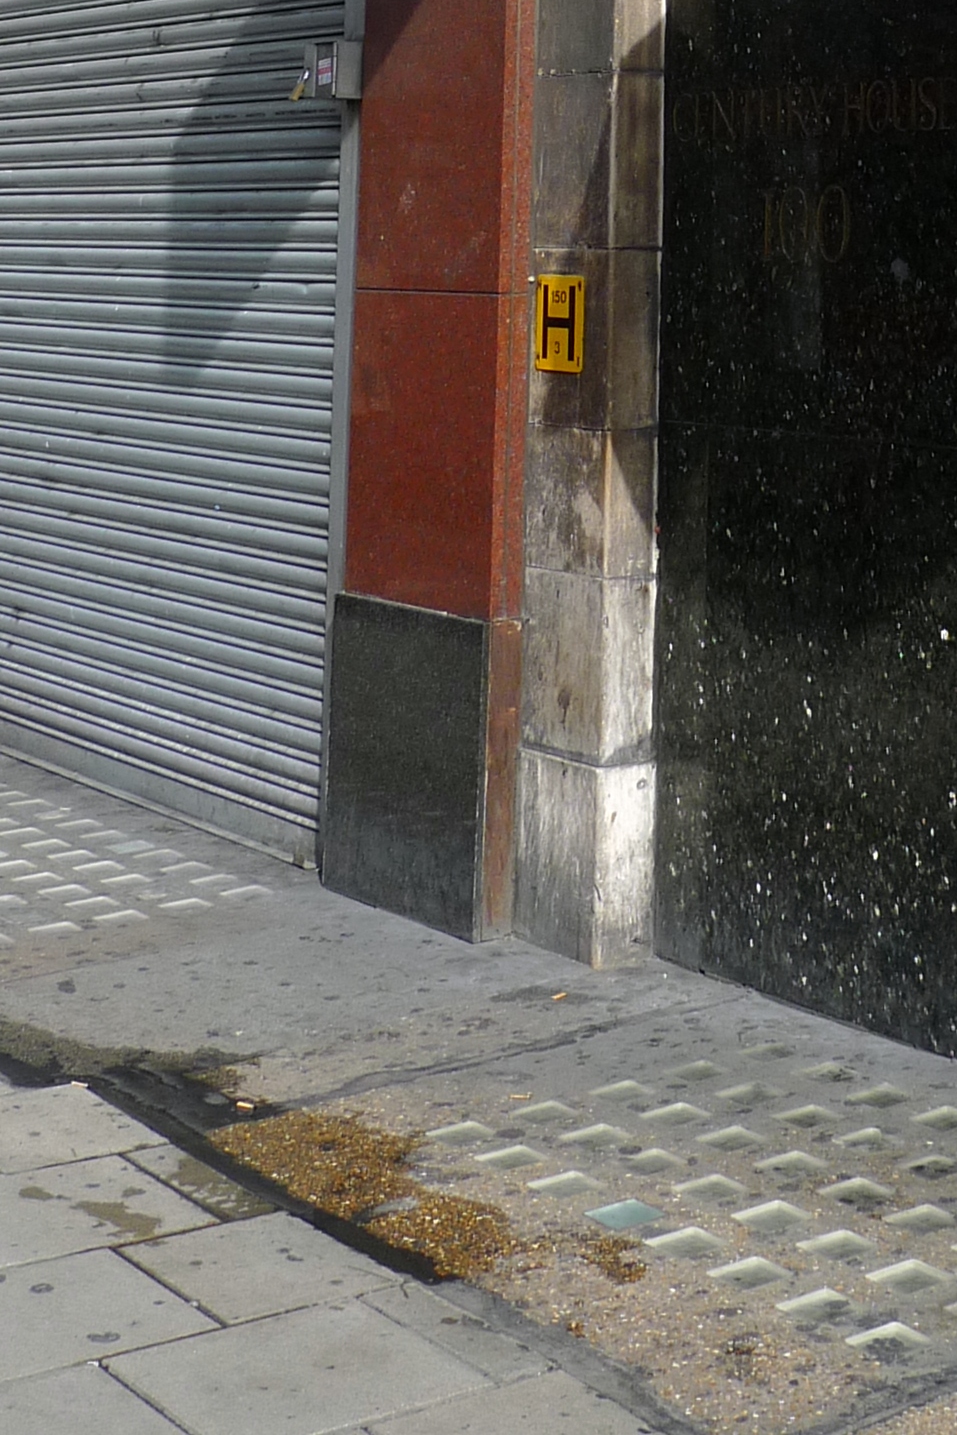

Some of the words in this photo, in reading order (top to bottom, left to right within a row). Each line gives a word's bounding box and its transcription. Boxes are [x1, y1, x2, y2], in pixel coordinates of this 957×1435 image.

[763, 184, 850, 264] 100
[552, 291, 567, 304] 150
[541, 284, 576, 361] H
[554, 341, 561, 354] 3
